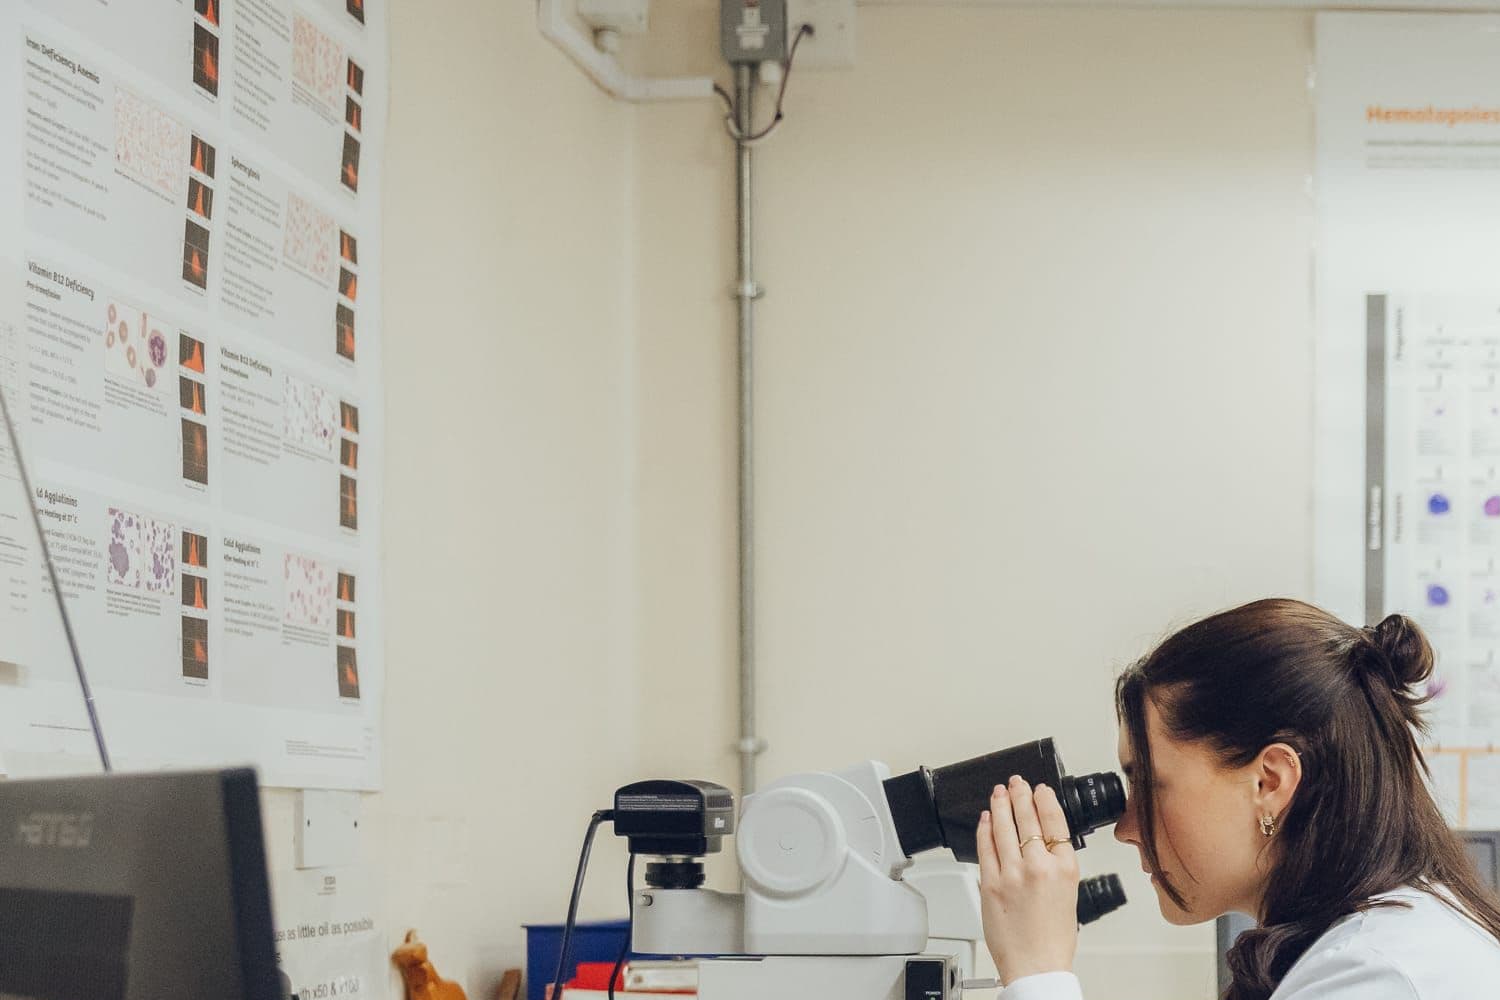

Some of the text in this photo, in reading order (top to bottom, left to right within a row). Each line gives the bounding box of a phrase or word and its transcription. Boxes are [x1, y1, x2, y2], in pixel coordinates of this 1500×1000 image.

[41, 44, 77, 74] Deficiency
[28, 261, 96, 301] Vitamin B12 Deficiency
[318, 921, 330, 936] oil
[330, 981, 338, 996] &
